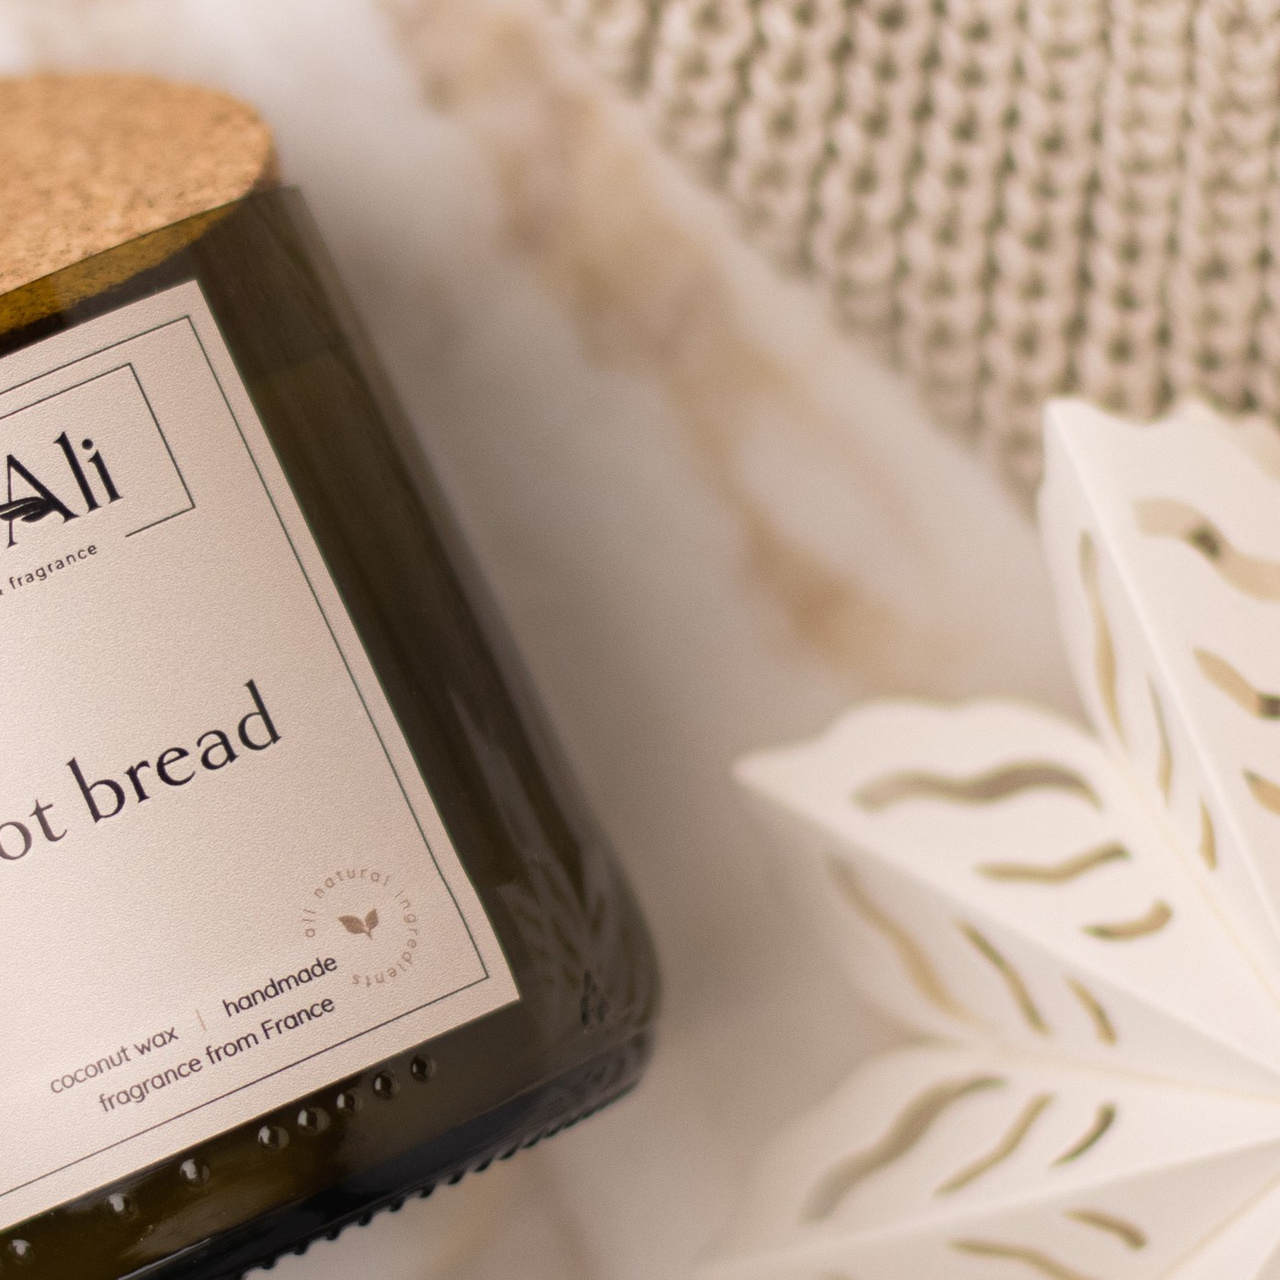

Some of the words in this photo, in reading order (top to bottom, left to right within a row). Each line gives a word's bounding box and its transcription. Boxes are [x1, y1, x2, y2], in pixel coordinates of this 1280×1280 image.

[8, 542, 99, 590] fragrance
[65, 678, 283, 824] bread
[301, 908, 316, 939] all
[313, 868, 390, 899] natural
[49, 1044, 132, 1094] coconut
[132, 1026, 180, 1056] wax
[222, 956, 339, 1018] handmade
[98, 1056, 204, 1113] fragrance
[204, 1030, 260, 1066] from
[260, 997, 336, 1040] France
